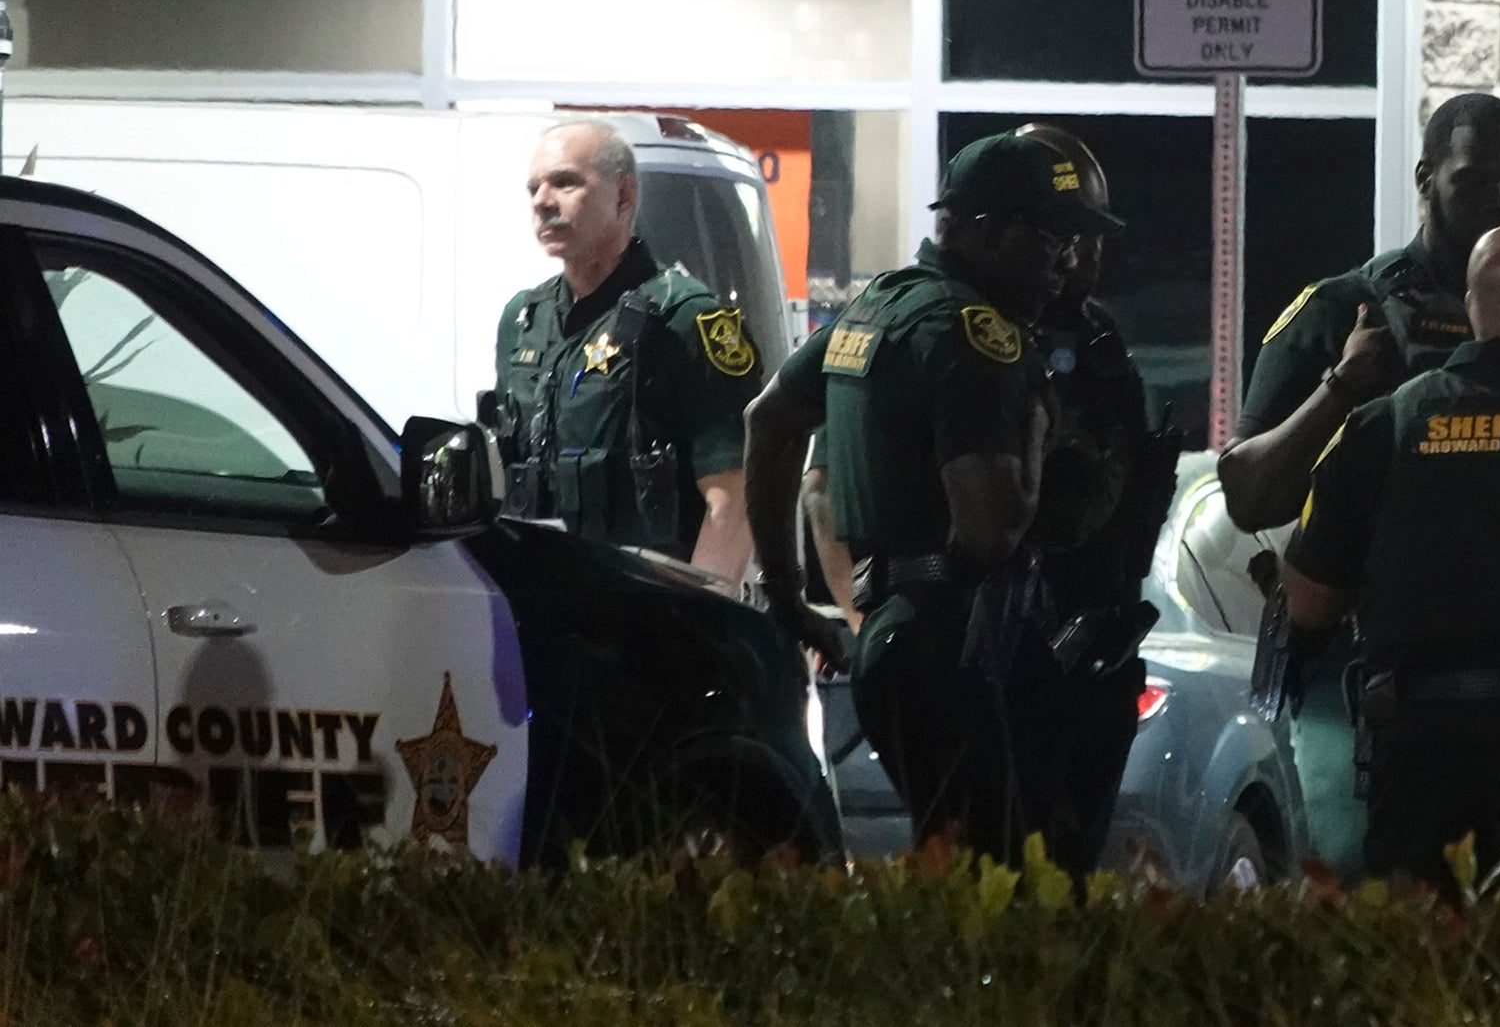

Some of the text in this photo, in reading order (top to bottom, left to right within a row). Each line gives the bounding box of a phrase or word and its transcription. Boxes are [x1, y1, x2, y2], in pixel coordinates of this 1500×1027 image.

[1191, 16, 1261, 34] PERMIT
[1201, 42, 1253, 61] ONLY
[1418, 438, 1500, 455] BROWARD
[0, 697, 382, 761] WARD COUNTY
